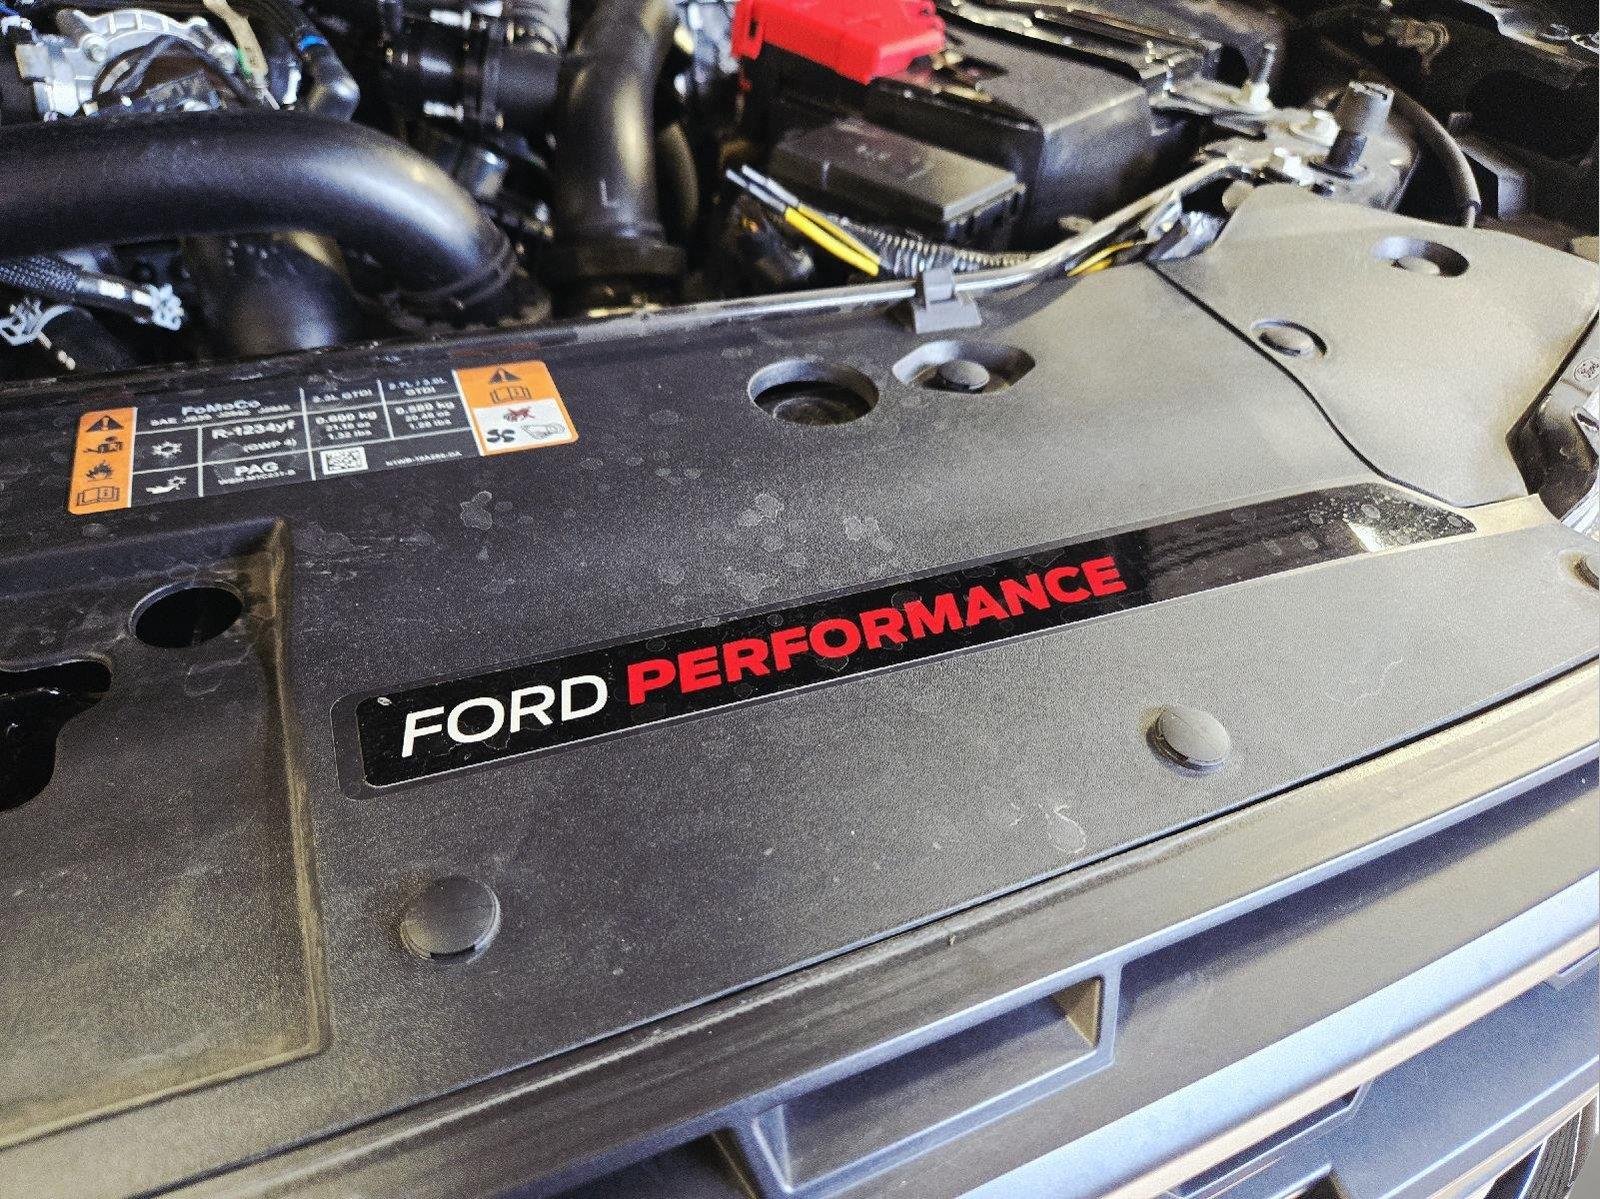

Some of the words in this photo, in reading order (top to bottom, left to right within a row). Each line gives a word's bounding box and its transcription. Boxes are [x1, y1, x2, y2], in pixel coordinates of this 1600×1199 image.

[181, 399, 261, 416] FoMoCo
[358, 410, 378, 421] kg
[211, 419, 296, 439] R-1234yf
[234, 461, 280, 477] PAG
[401, 674, 609, 758] FORD
[627, 556, 1126, 705] PERFORMANCE
